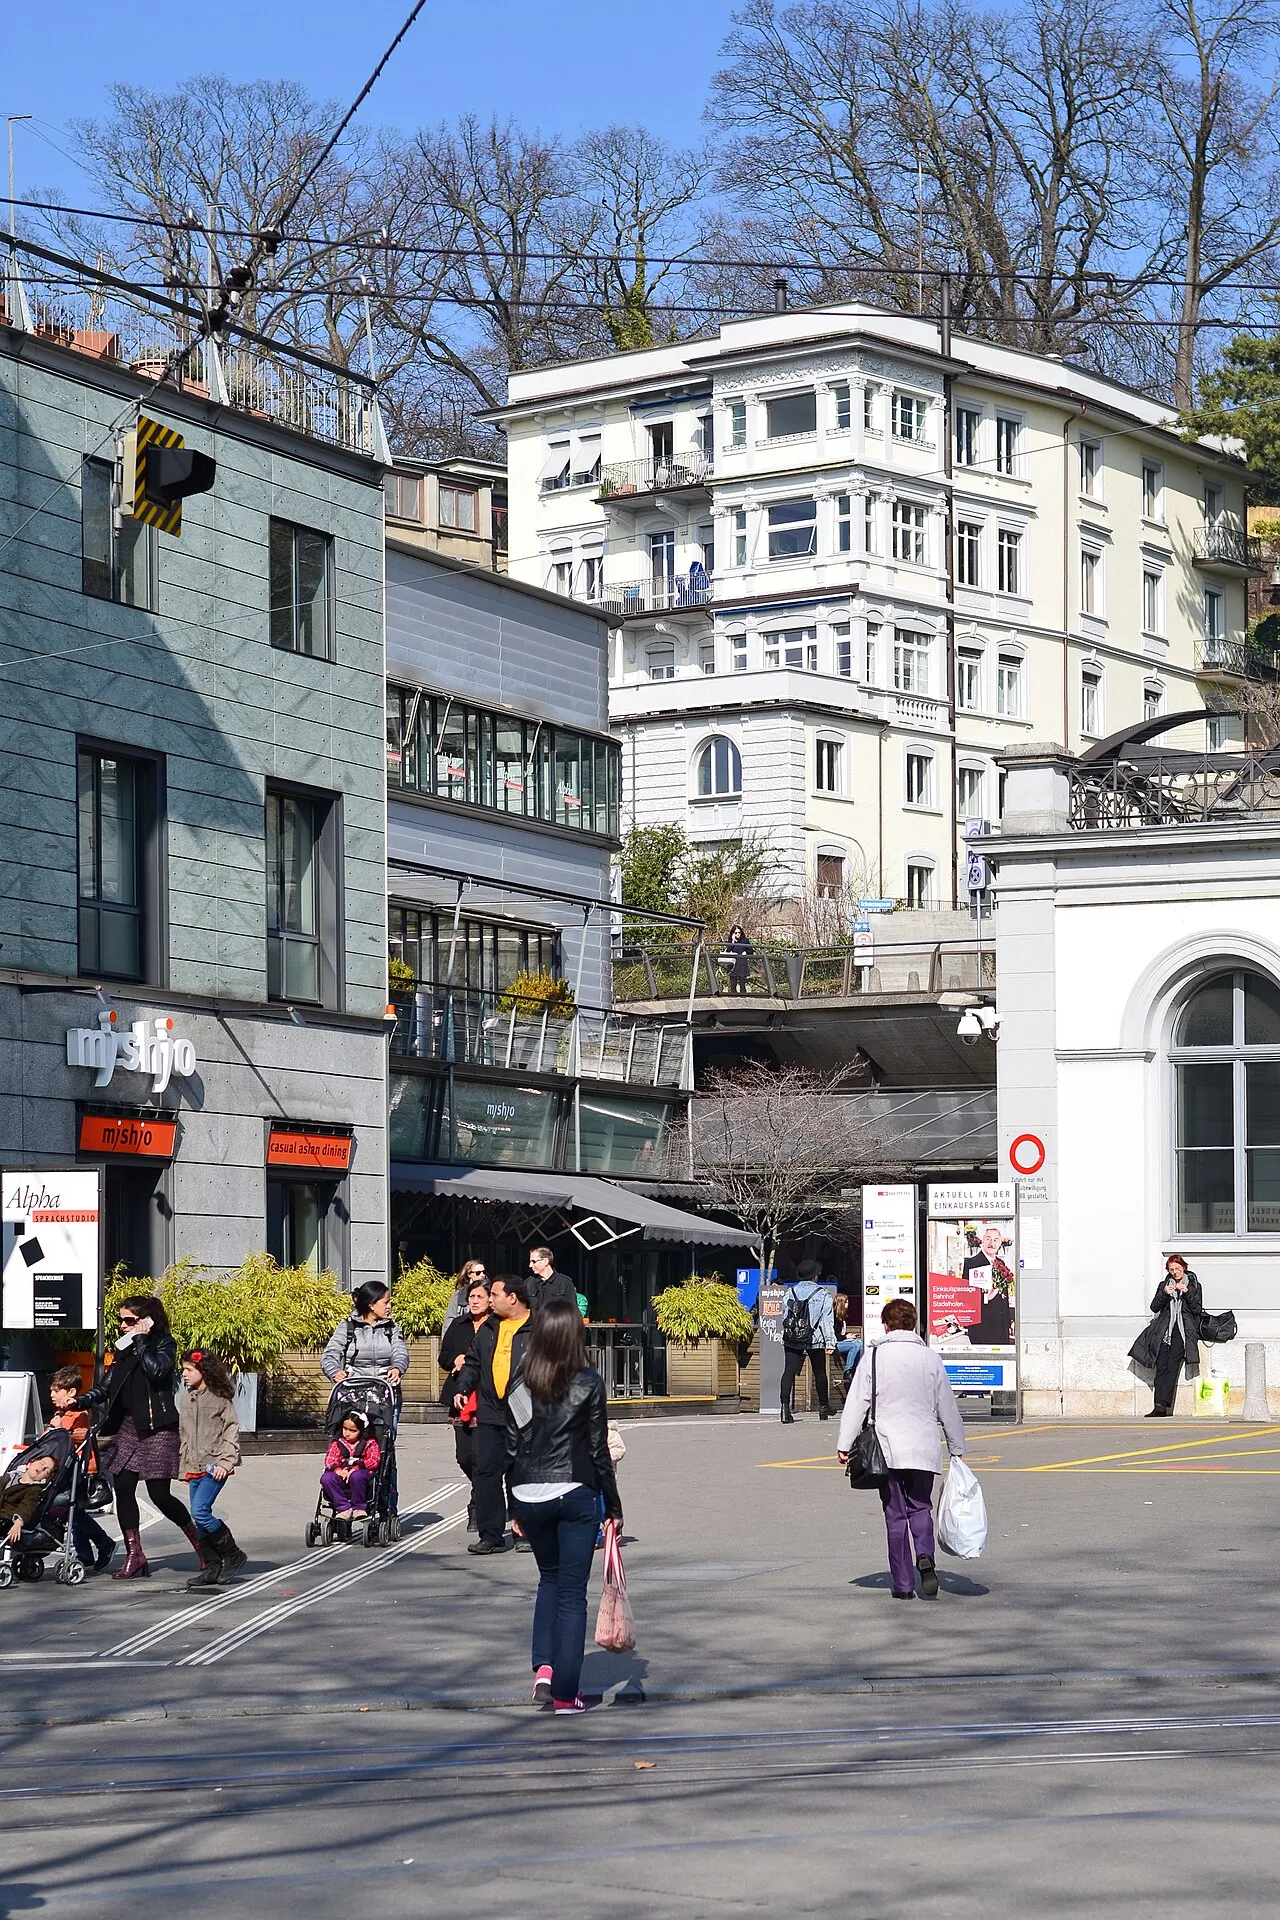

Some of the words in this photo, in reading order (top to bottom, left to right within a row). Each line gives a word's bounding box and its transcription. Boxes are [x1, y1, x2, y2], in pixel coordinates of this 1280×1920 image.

[270, 1141, 297, 1154] casual
[298, 1143, 321, 1156] asian
[322, 1143, 347, 1160] dining
[934, 1191, 973, 1199] AKTUELL
[993, 1190, 1011, 1198] DER
[5, 1184, 61, 1216] Alpha
[934, 1201, 1011, 1209] EINKAUFSPASSAGE
[35, 1214, 96, 1222] SPRACHSTUDIO
